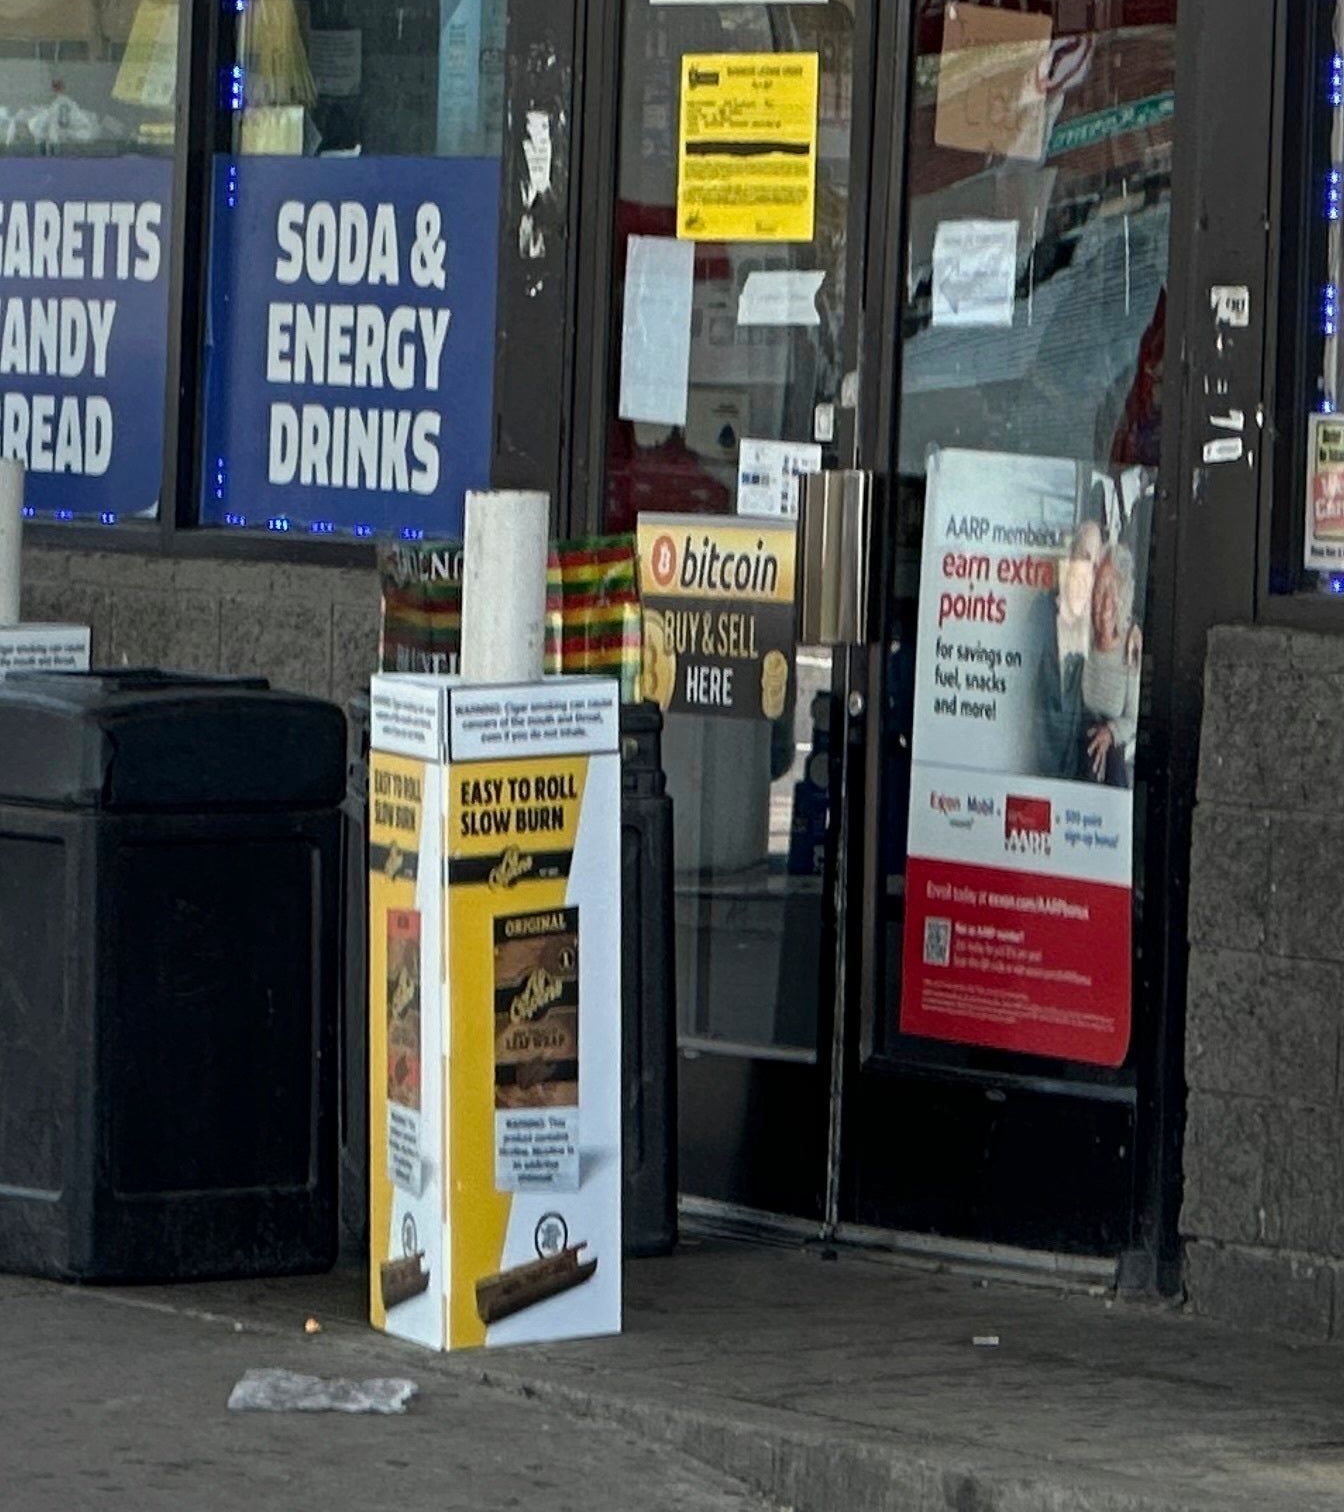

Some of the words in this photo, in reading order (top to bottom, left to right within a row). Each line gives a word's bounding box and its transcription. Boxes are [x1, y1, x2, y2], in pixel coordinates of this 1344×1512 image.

[276, 201, 399, 286] SODA
[410, 201, 447, 290] &
[266, 303, 451, 392] ENERGY
[268, 402, 441, 495] DRINKS
[945, 514, 990, 539] AARP
[680, 534, 779, 593] bitcoin
[942, 551, 990, 581] earn
[997, 555, 1055, 588] extra
[938, 586, 1007, 630] points
[663, 610, 700, 656] BUY
[702, 613, 716, 656] &
[718, 613, 759, 660] SELL
[935, 636, 953, 660] for
[957, 640, 1003, 668] savings
[1005, 650, 1022, 667] on
[686, 665, 734, 707] HERE
[934, 666, 960, 693] fuel,
[964, 669, 1006, 694] snacks
[933, 694, 957, 717] and
[960, 700, 996, 721] more!
[460, 778, 504, 807] EASY
[507, 776, 531, 802] TO
[534, 773, 578, 801] ROLL
[460, 808, 511, 837] SLOW
[516, 806, 564, 832] BURN
[505, 913, 567, 937] ORIGINAL
